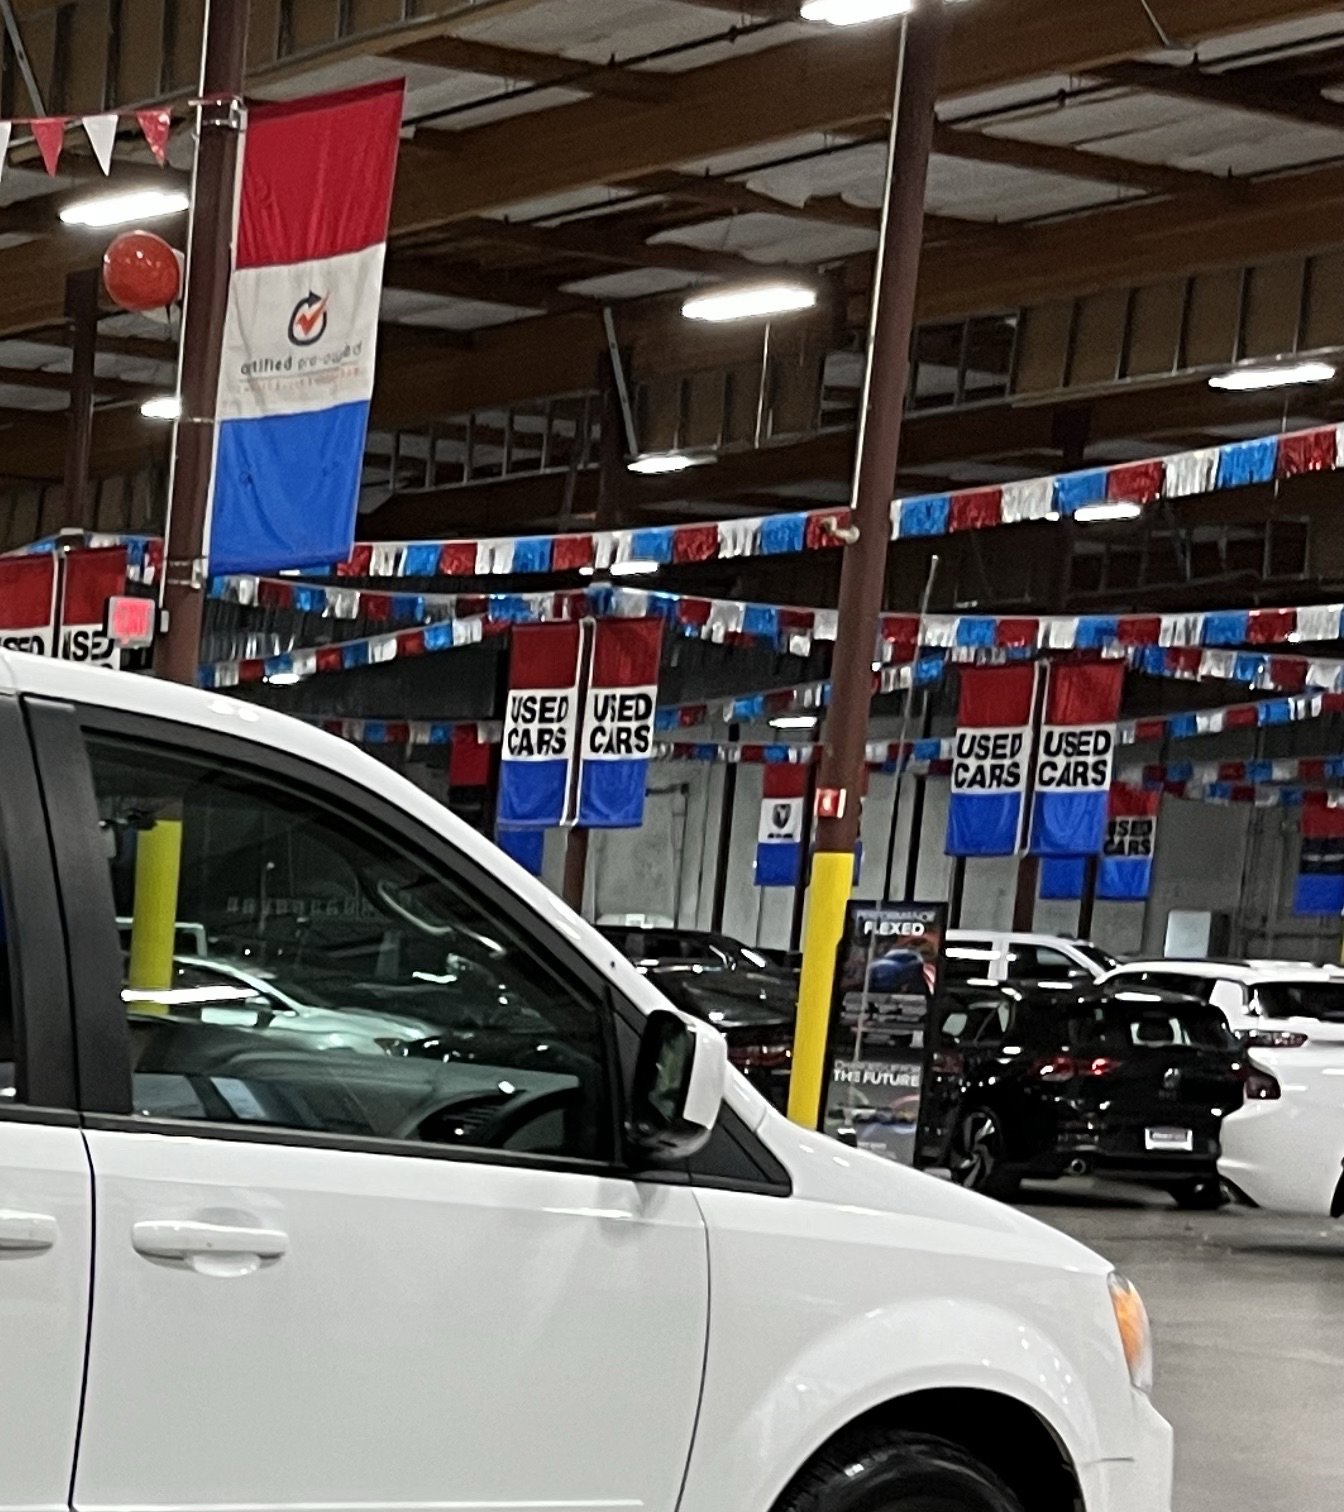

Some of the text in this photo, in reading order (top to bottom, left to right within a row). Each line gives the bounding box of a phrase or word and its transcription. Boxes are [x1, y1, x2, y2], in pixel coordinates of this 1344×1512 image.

[240, 355, 293, 375] ctified
[511, 695, 569, 723] USED
[593, 693, 653, 722] USED
[507, 727, 567, 756] CARS
[589, 724, 651, 754] CARS
[956, 733, 1024, 760] USED
[1043, 730, 1112, 757] USED
[953, 762, 1021, 788] CARS
[1038, 760, 1108, 787] CARS
[1104, 838, 1152, 855] CARS
[833, 1068, 861, 1083] THE
[863, 1070, 920, 1088] FUTURE
